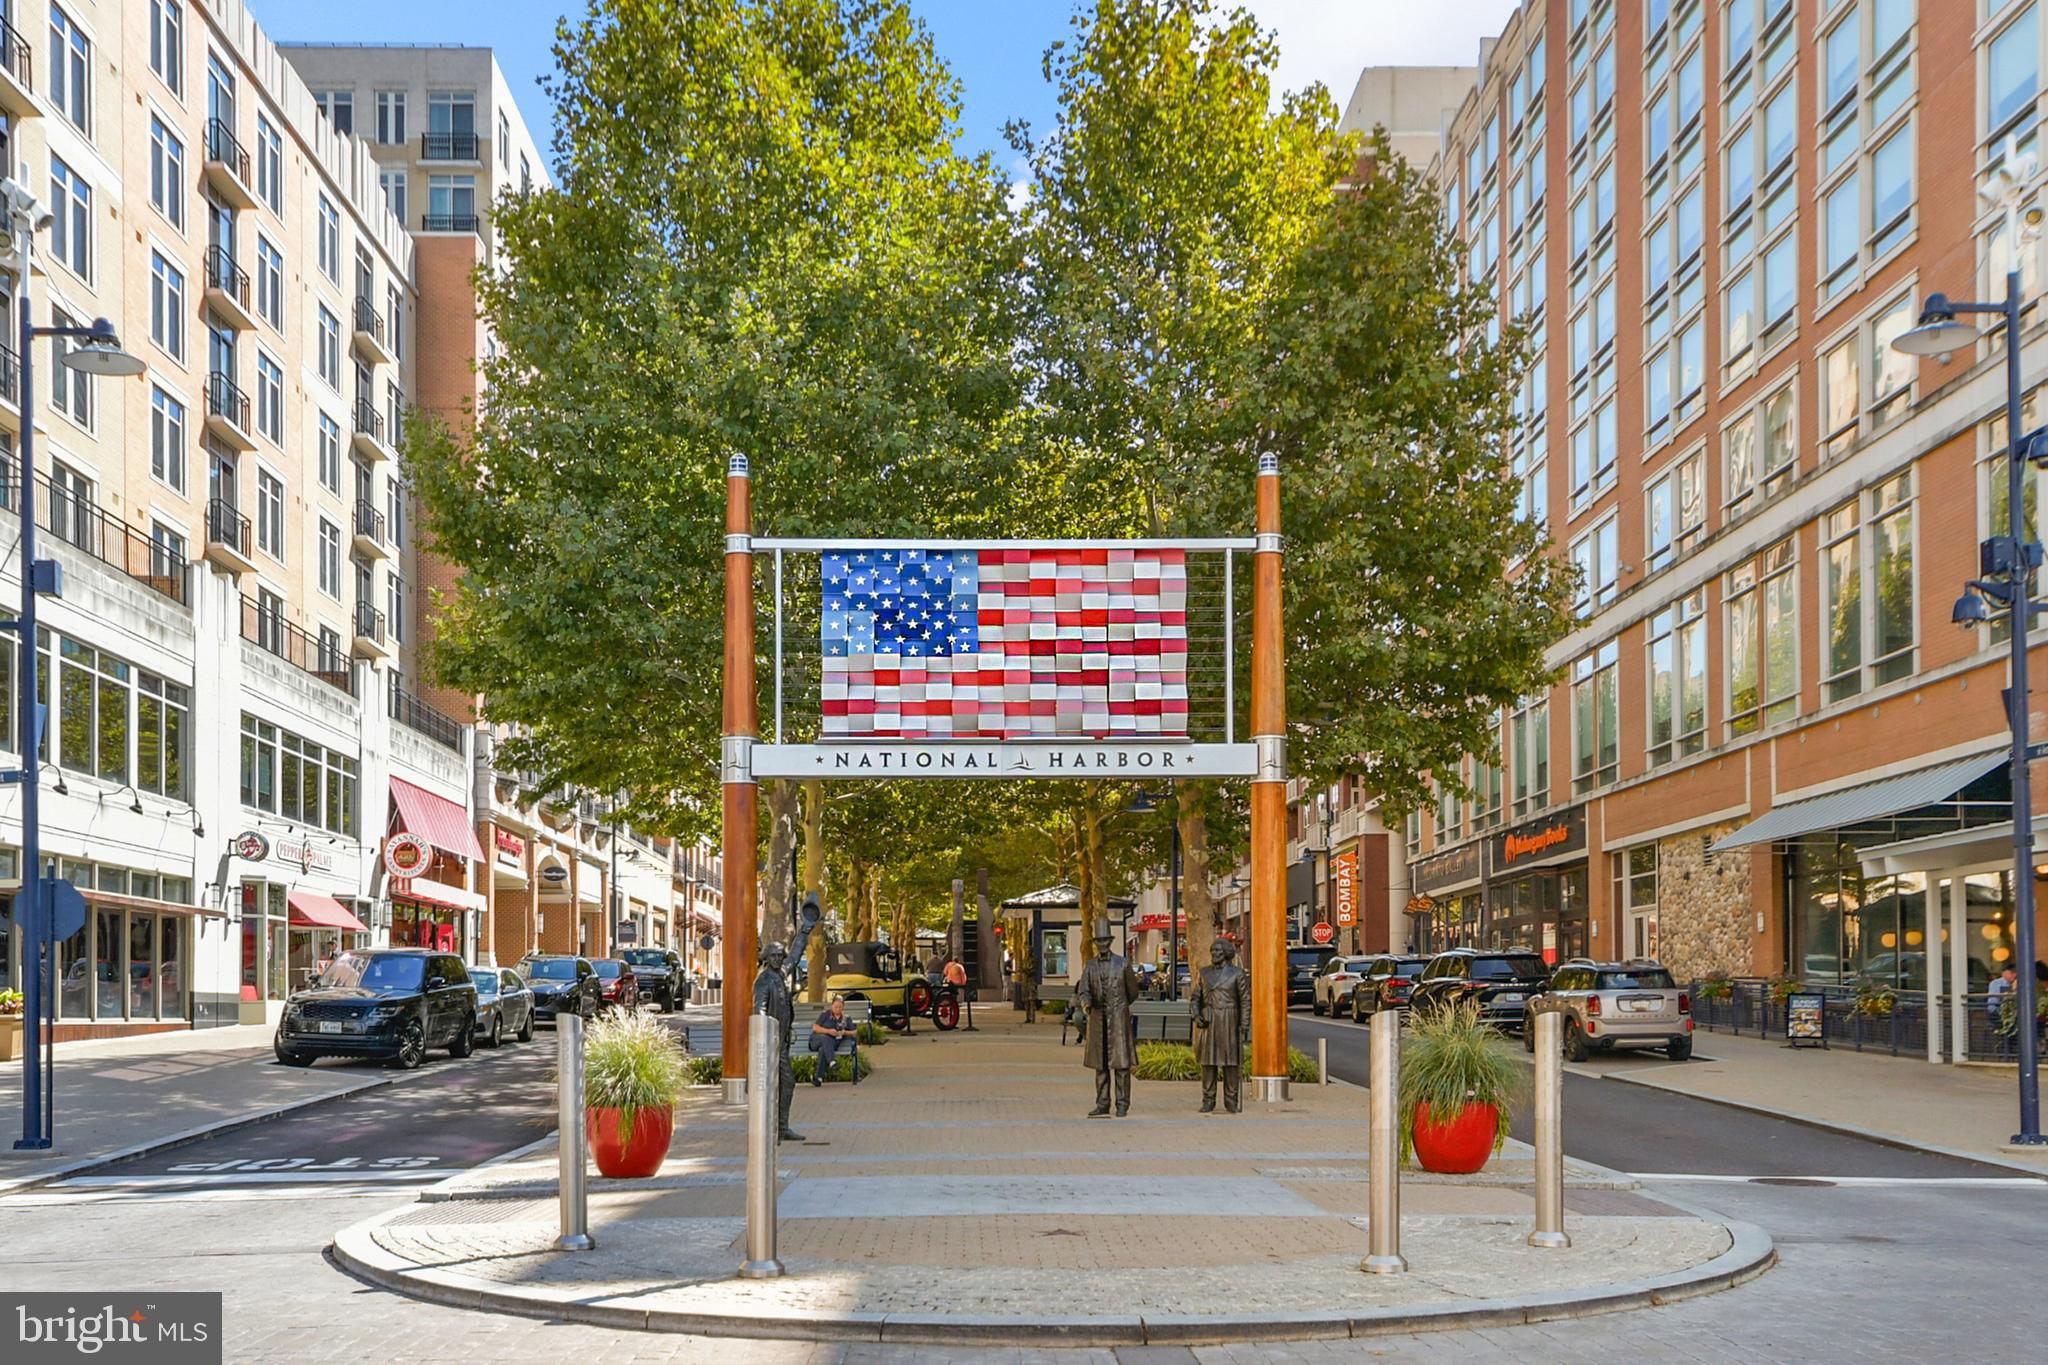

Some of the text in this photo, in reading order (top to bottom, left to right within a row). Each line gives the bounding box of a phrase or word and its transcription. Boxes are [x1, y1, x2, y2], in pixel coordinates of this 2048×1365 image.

[834, 752, 1175, 767] NATIONAL HARBOR
[1339, 859, 1351, 922] BOMBAY
[1313, 928, 1331, 937] STOP
